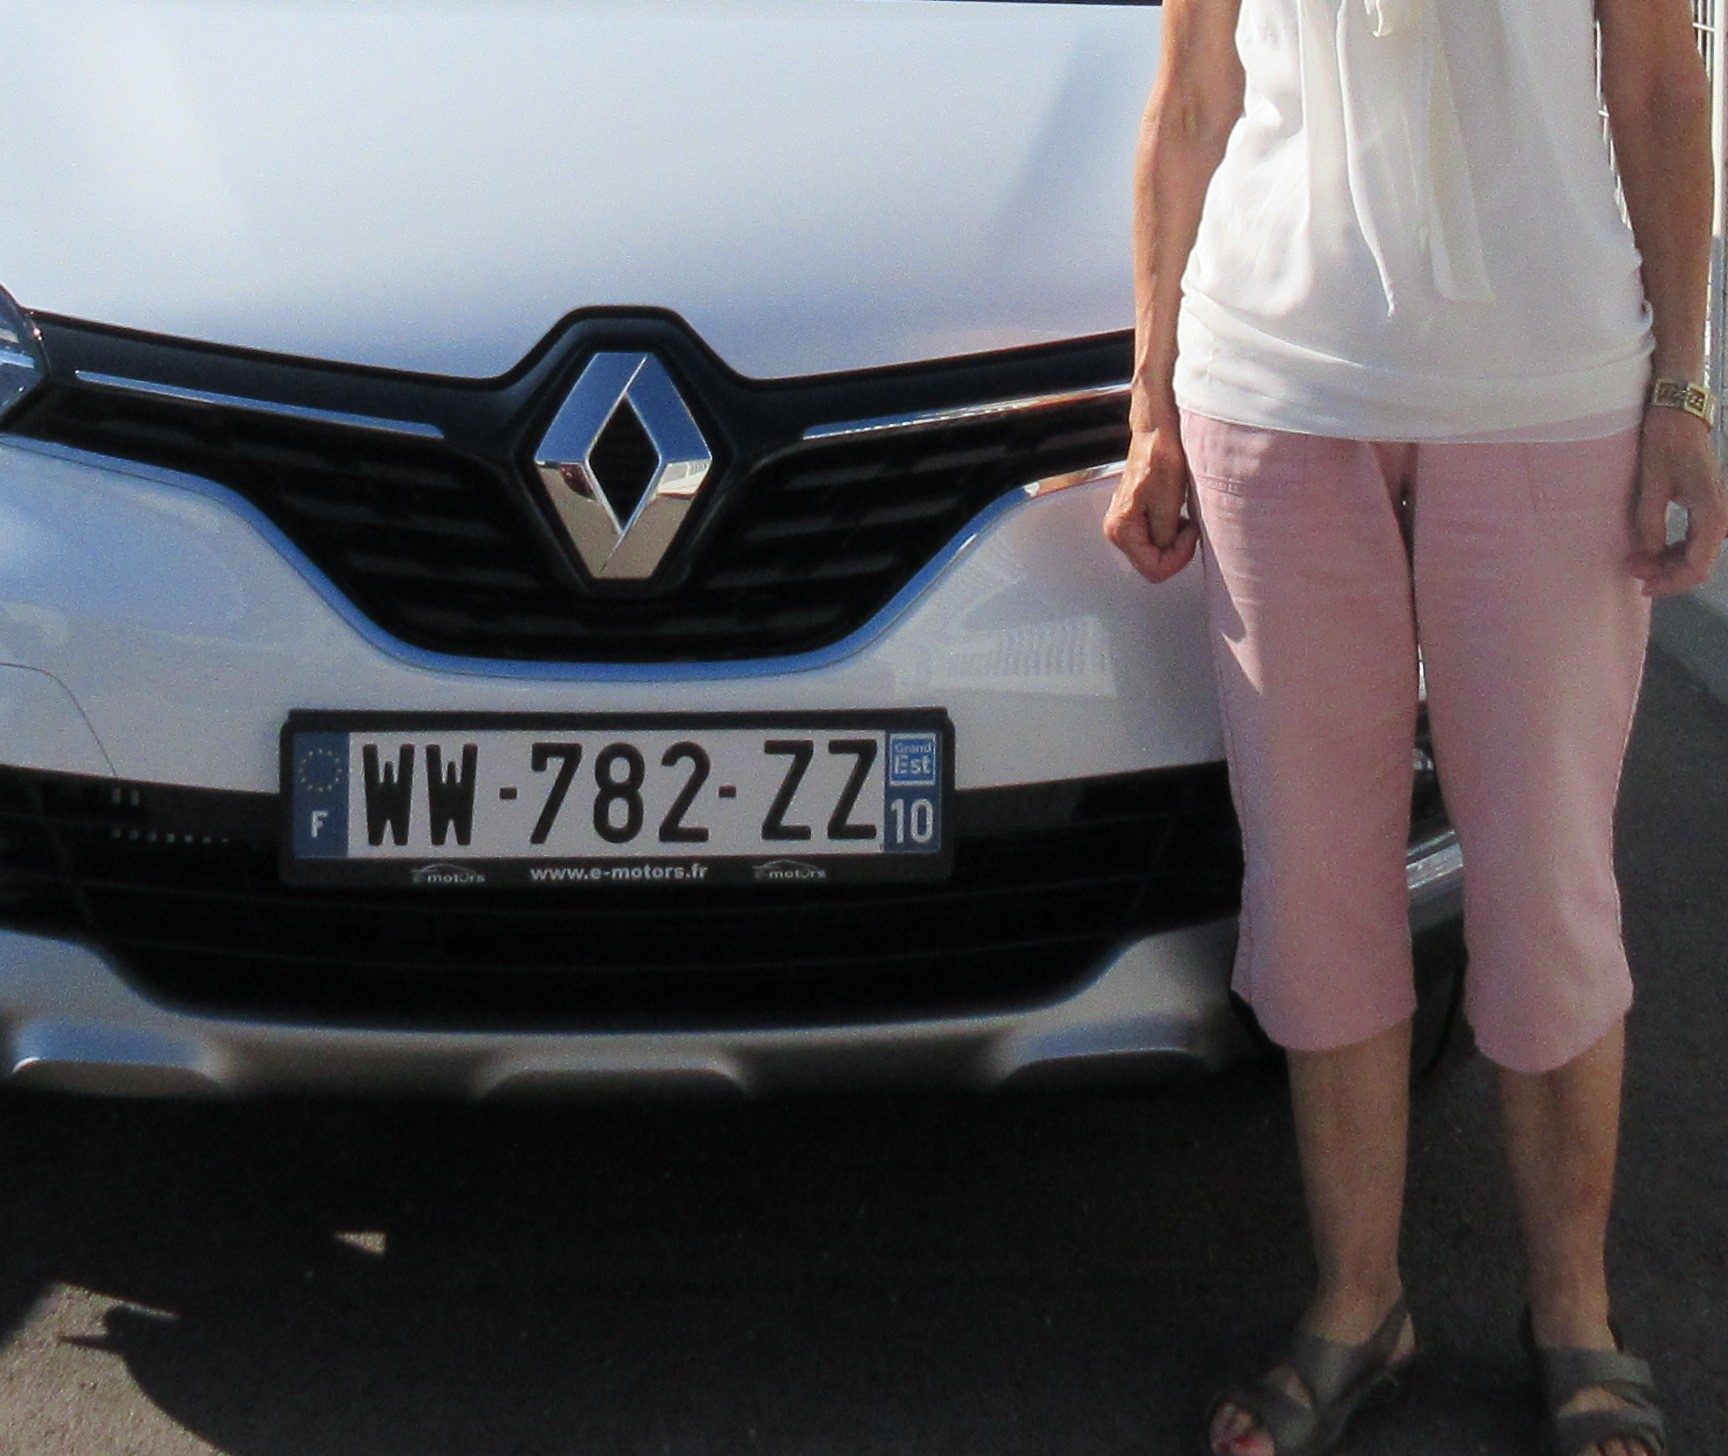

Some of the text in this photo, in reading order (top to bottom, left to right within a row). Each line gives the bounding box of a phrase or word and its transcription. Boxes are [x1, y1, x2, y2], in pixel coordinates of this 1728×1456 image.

[894, 742, 932, 754] Grand
[894, 754, 932, 775] Est
[362, 739, 878, 846] WW-782-ZZ
[310, 809, 329, 838] F
[890, 797, 933, 844] 10
[530, 862, 709, 881] www.e-motors.fr
